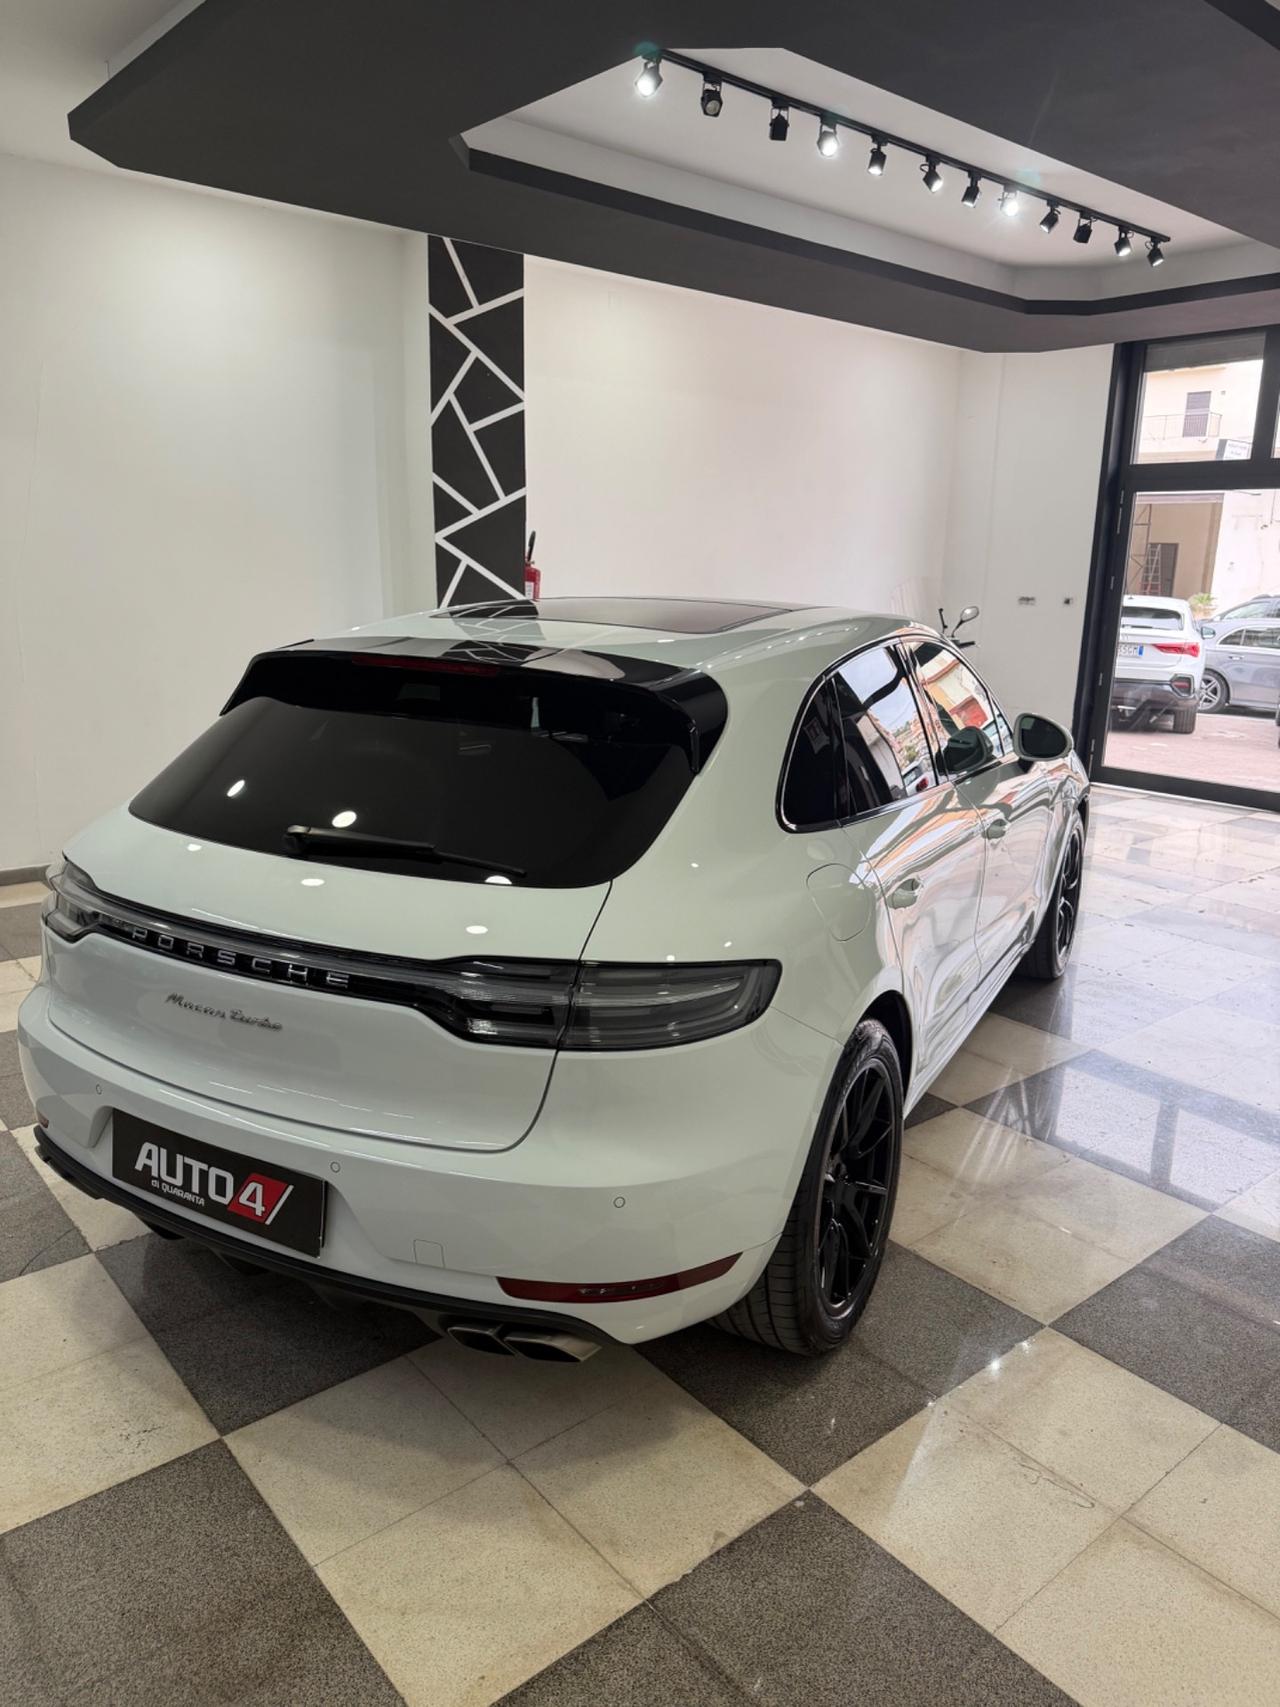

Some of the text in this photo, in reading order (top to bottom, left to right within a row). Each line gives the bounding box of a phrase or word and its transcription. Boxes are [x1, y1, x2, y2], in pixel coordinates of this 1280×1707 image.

[131, 926, 349, 989] PORSCHE
[165, 992, 283, 1031] Macan Turbo
